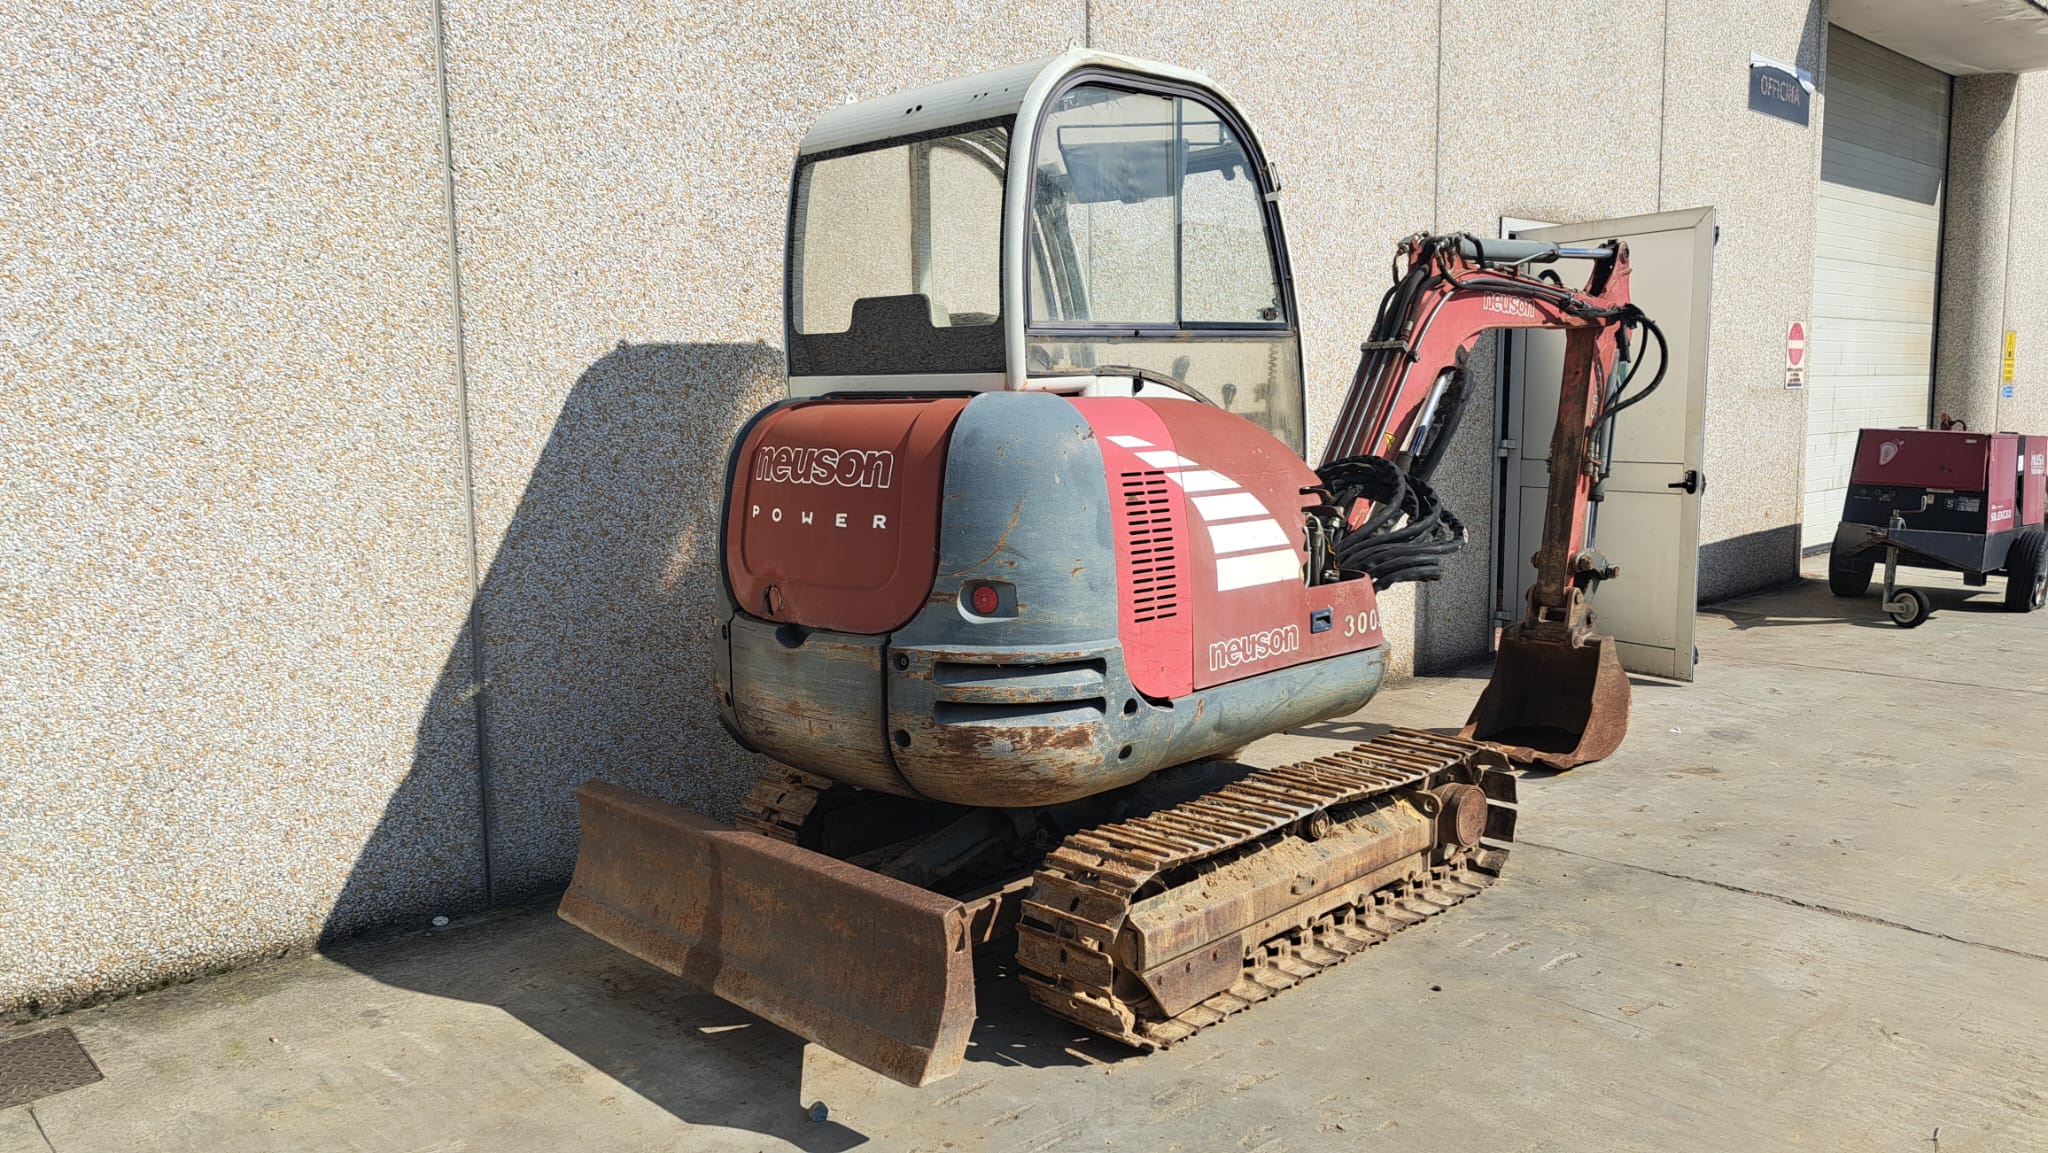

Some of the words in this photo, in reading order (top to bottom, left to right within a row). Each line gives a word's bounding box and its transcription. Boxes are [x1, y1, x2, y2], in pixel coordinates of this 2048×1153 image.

[1483, 290, 1536, 318] neuson
[756, 446, 894, 488] neuson
[752, 505, 887, 529] POWER
[1343, 608, 1381, 638] 300
[1209, 623, 1300, 672] neuson
